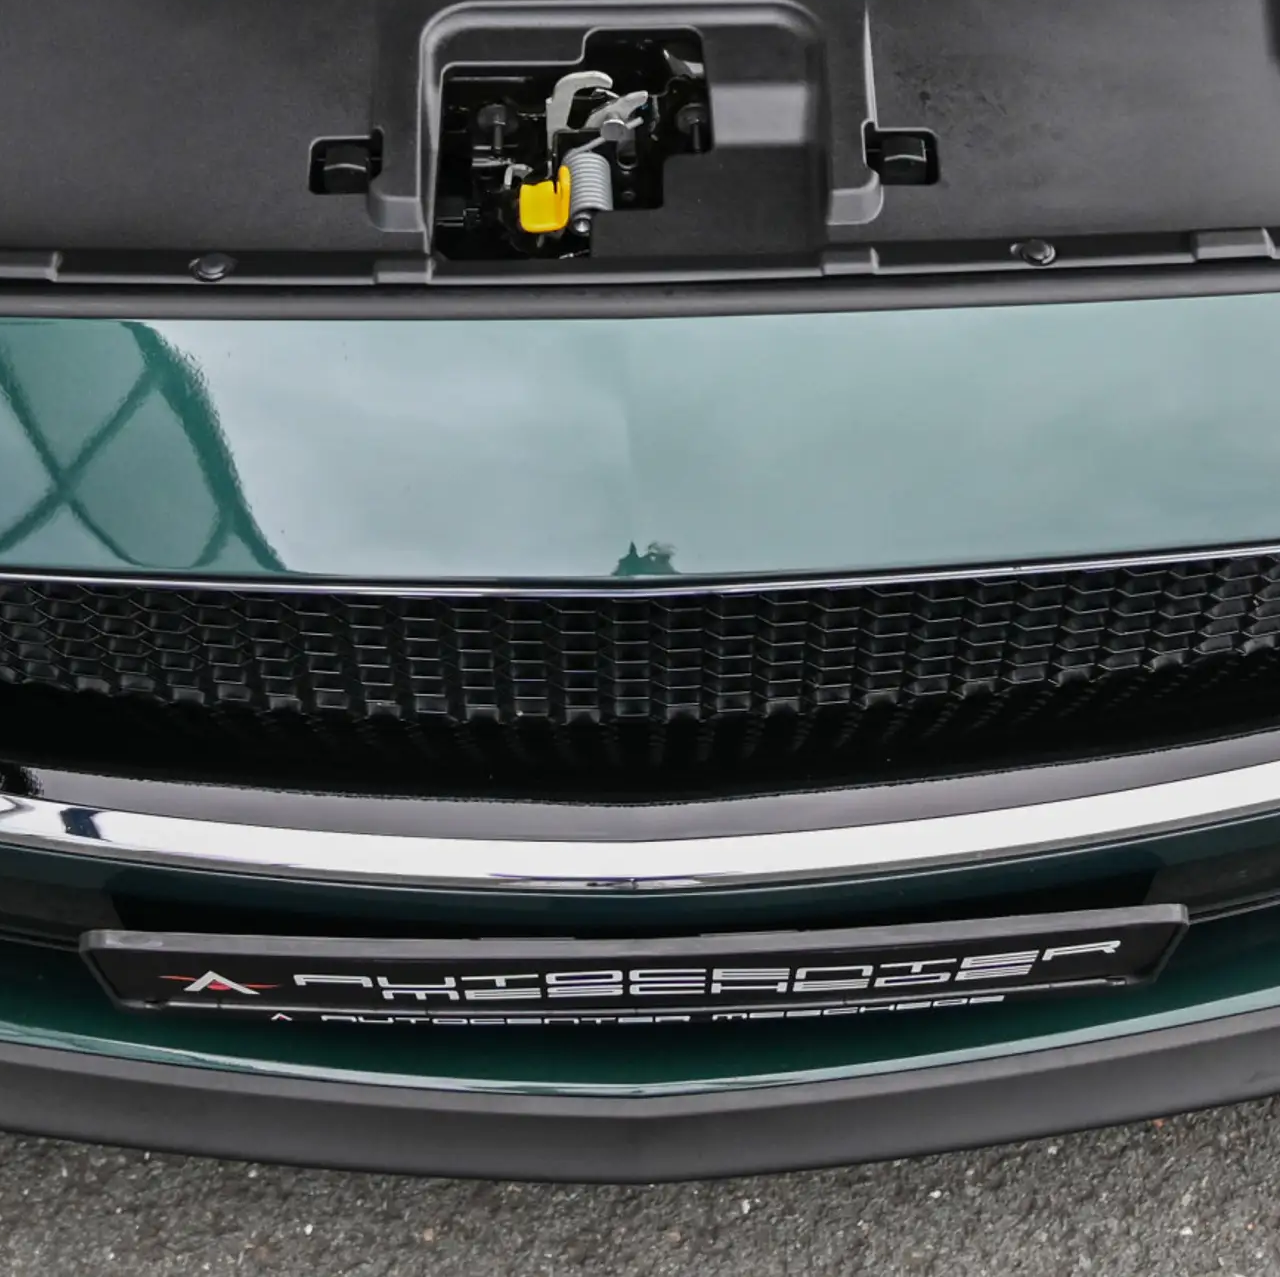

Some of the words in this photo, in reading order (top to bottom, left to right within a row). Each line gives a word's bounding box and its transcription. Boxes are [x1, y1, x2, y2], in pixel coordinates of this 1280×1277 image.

[293, 939, 1122, 988] AUTOCENTER
[321, 1014, 690, 1025] AUTOCENTER
[713, 995, 1005, 1021] MESCHEDE
